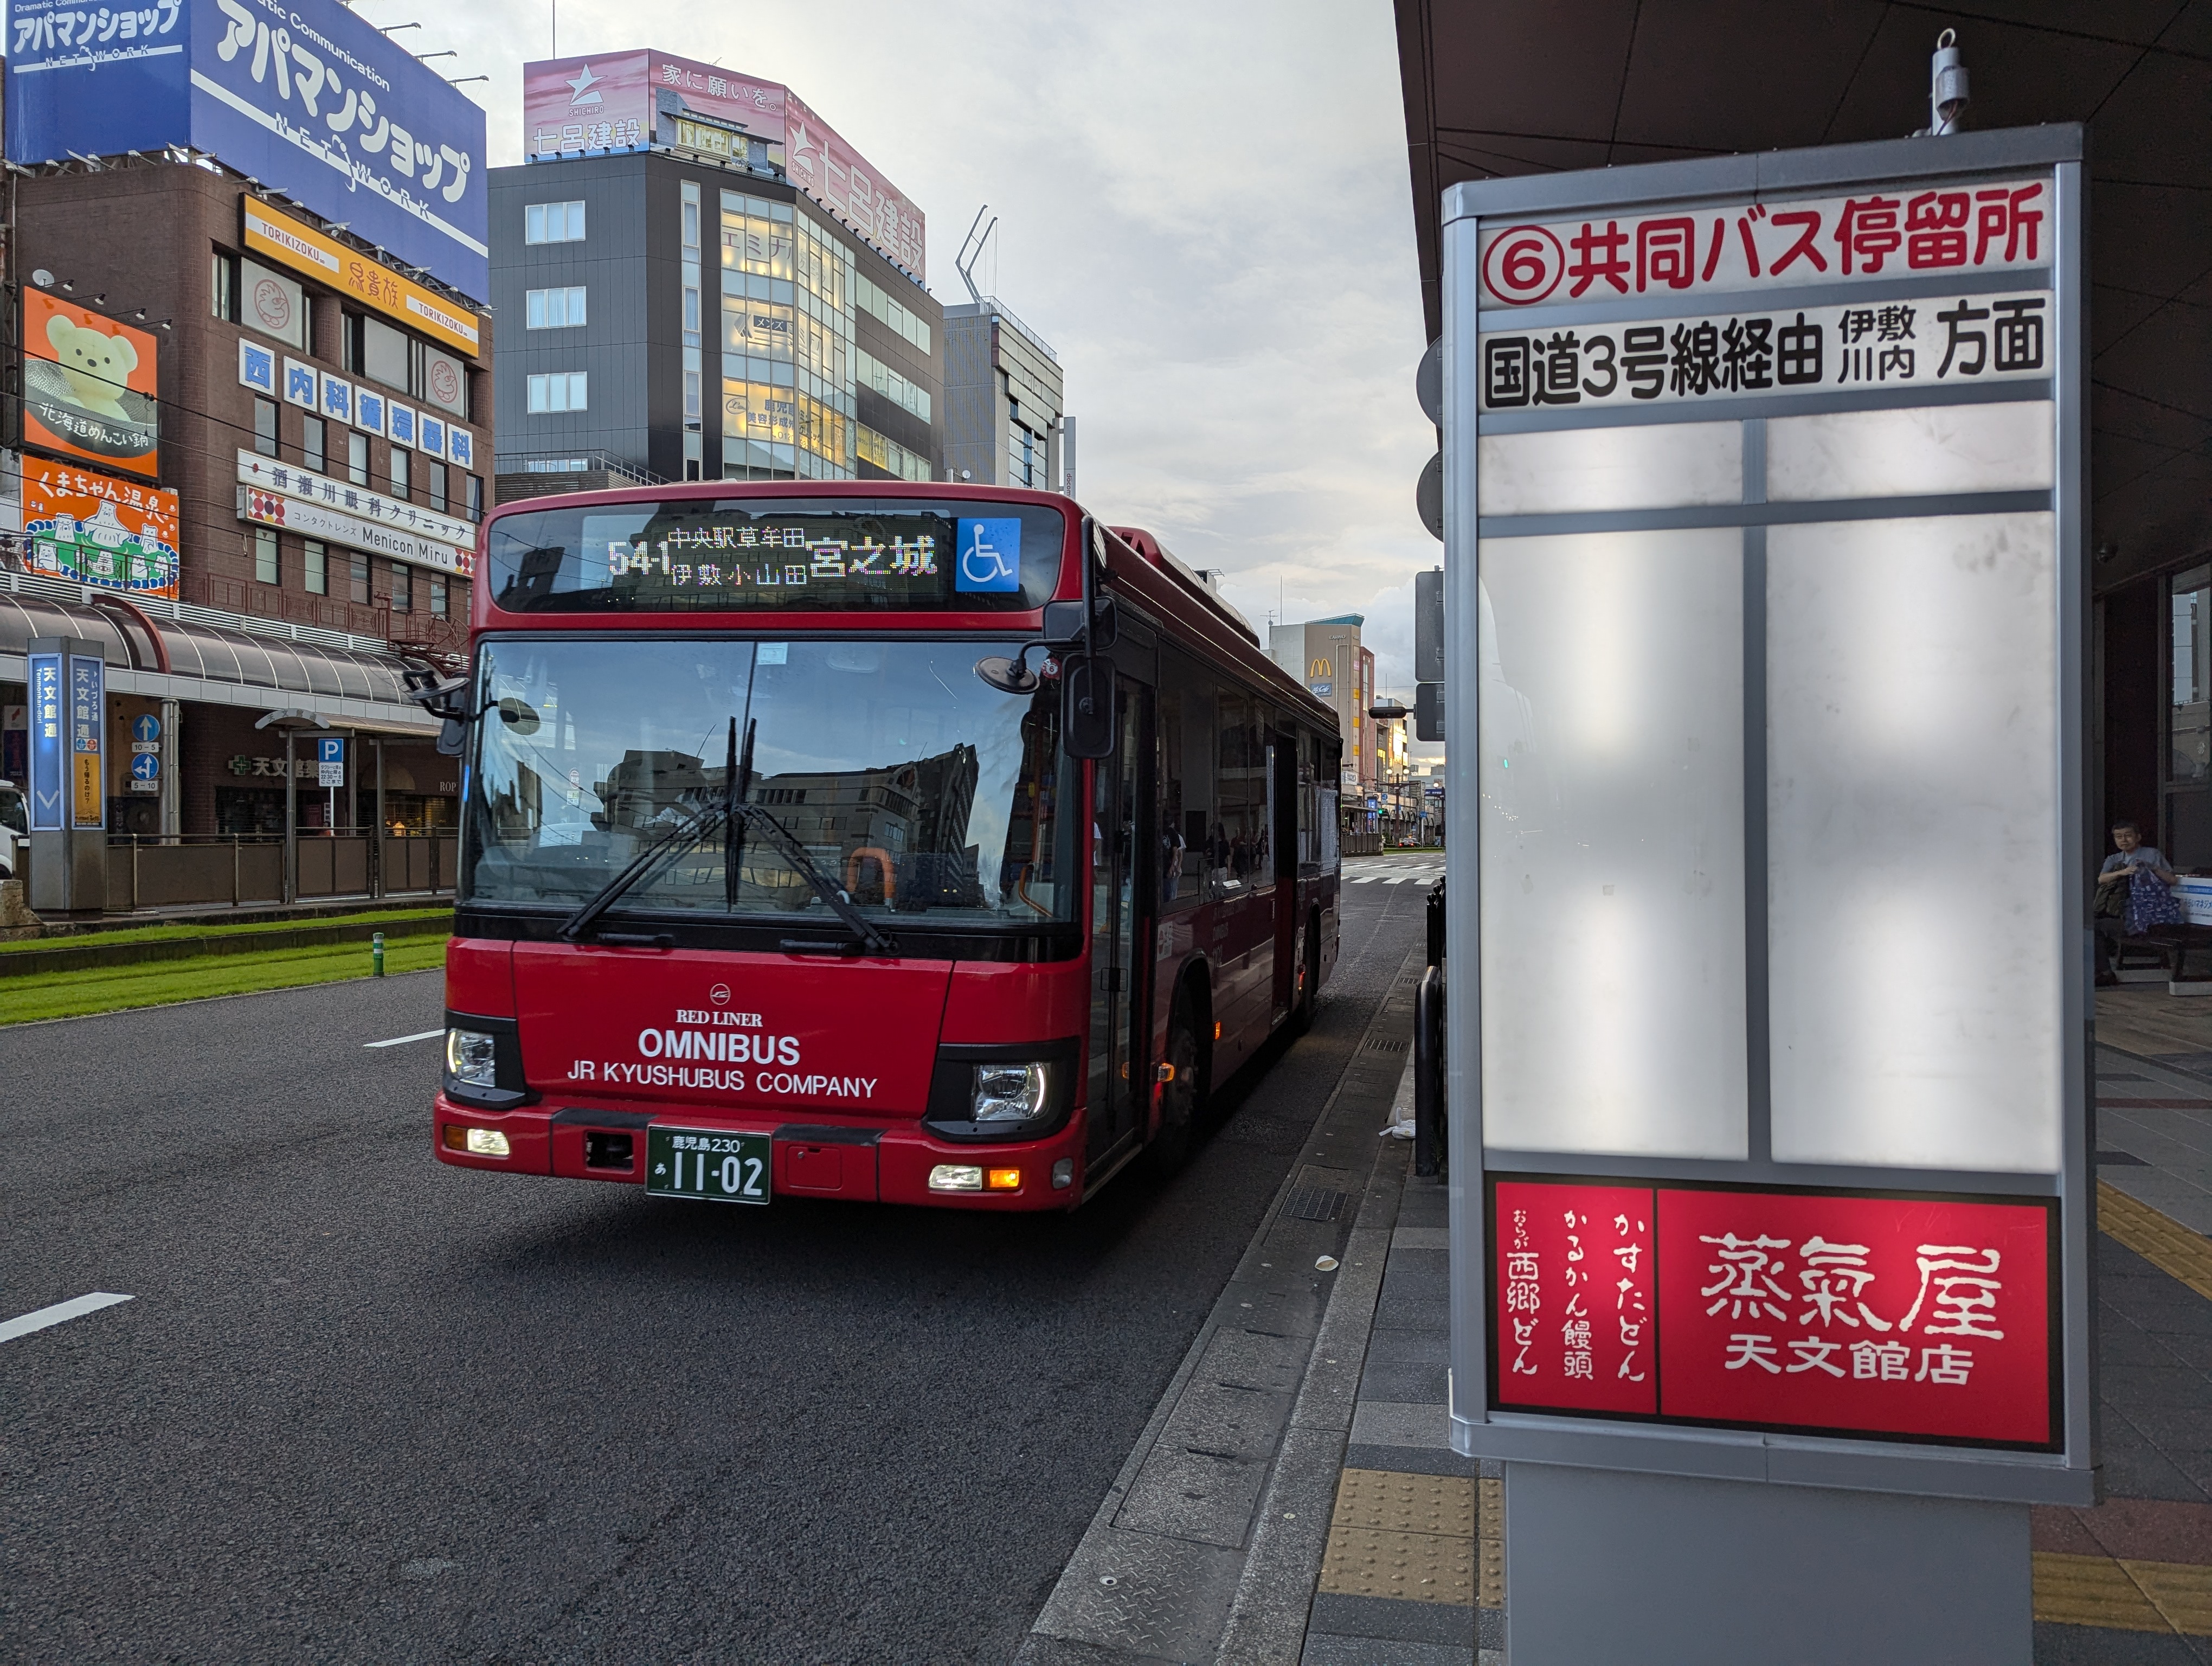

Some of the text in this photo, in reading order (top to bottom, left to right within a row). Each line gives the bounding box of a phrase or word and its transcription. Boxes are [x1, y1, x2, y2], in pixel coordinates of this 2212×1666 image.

[14, 0, 182, 53] アパマンショップ
[290, 12, 390, 92] Communication
[217, 0, 471, 203] アパマンショップ
[661, 63, 777, 112] 家に願いを。
[568, 105, 605, 117] SHICHIRO
[532, 118, 641, 156] 七呂建設
[791, 161, 815, 187] SHICHIRO
[819, 139, 923, 277] 七呂建設
[262, 222, 319, 261] TORIKIZOKU
[418, 302, 464, 335] TORIKIZOKU
[756, 319, 784, 330] メンズ
[1485, 297, 2046, 409] 国道3号線経由 伊敷 方面
[1837, 344, 1917, 385] 川内
[38, 402, 149, 448] 北海道めんこい鍋
[245, 345, 470, 465] 西内科循環器科
[38, 471, 164, 523] くまちゃん温泉
[294, 511, 357, 536] コンタクトレンズ
[668, 527, 805, 549] 中央駅草牟田
[363, 527, 448, 565] Menicon Miru
[608, 541, 669, 575] 54-1
[805, 535, 937, 578] 宮之城
[671, 564, 807, 586] 伊敷小山田
[43, 667, 57, 738] 天文館通
[76, 668, 89, 738] 天文館通
[325, 741, 338, 760] P
[440, 781, 458, 792] ROP
[676, 1009, 763, 1027] RED LINER
[638, 1028, 801, 1066] OMNIBUS
[567, 1060, 878, 1098] JR KYUSHUBUS COMPANY
[654, 1151, 763, 1196] あ 11-02
[1560, 1210, 1594, 1380] かるかん饅頭
[1613, 1214, 1648, 1382] かすたどん
[1699, 1233, 2004, 1341] 蒸氣屋
[1725, 1334, 1975, 1386] 天文館店
